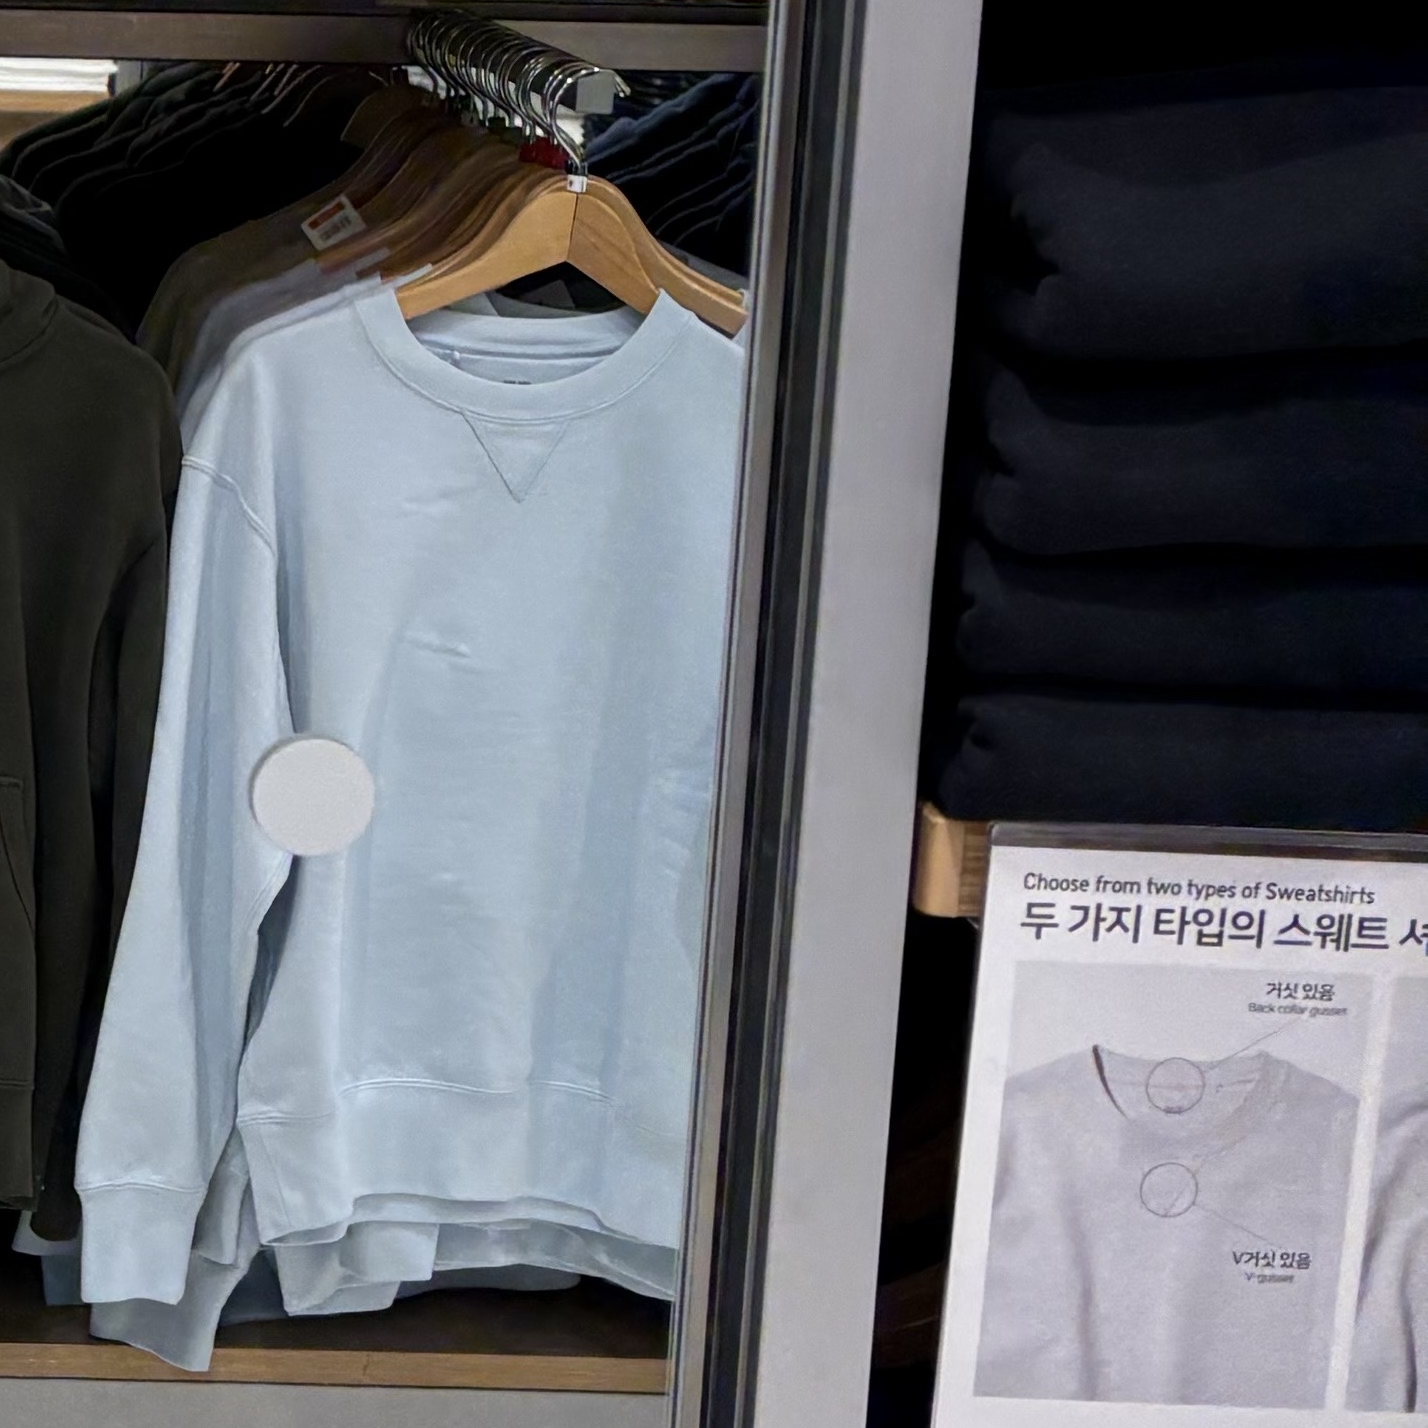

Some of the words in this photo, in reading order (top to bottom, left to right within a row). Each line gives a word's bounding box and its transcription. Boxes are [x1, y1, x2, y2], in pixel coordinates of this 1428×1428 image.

[1023, 871, 1089, 893] Choose
[1094, 876, 1141, 895] from
[1146, 878, 1182, 896] two
[1186, 880, 1236, 902] types
[1241, 881, 1261, 899] of
[1265, 882, 1375, 905] Sweatshirts
[1020, 901, 1059, 941] 두
[1068, 902, 1142, 944] 가지
[1153, 905, 1266, 949] 타입의
[1273, 912, 1390, 953] 스웨트
[1265, 981, 1299, 1000] 거싯
[1302, 982, 1335, 1002] 있음
[1232, 1250, 1275, 1269] V거싯
[1280, 1252, 1312, 1270] 있음
